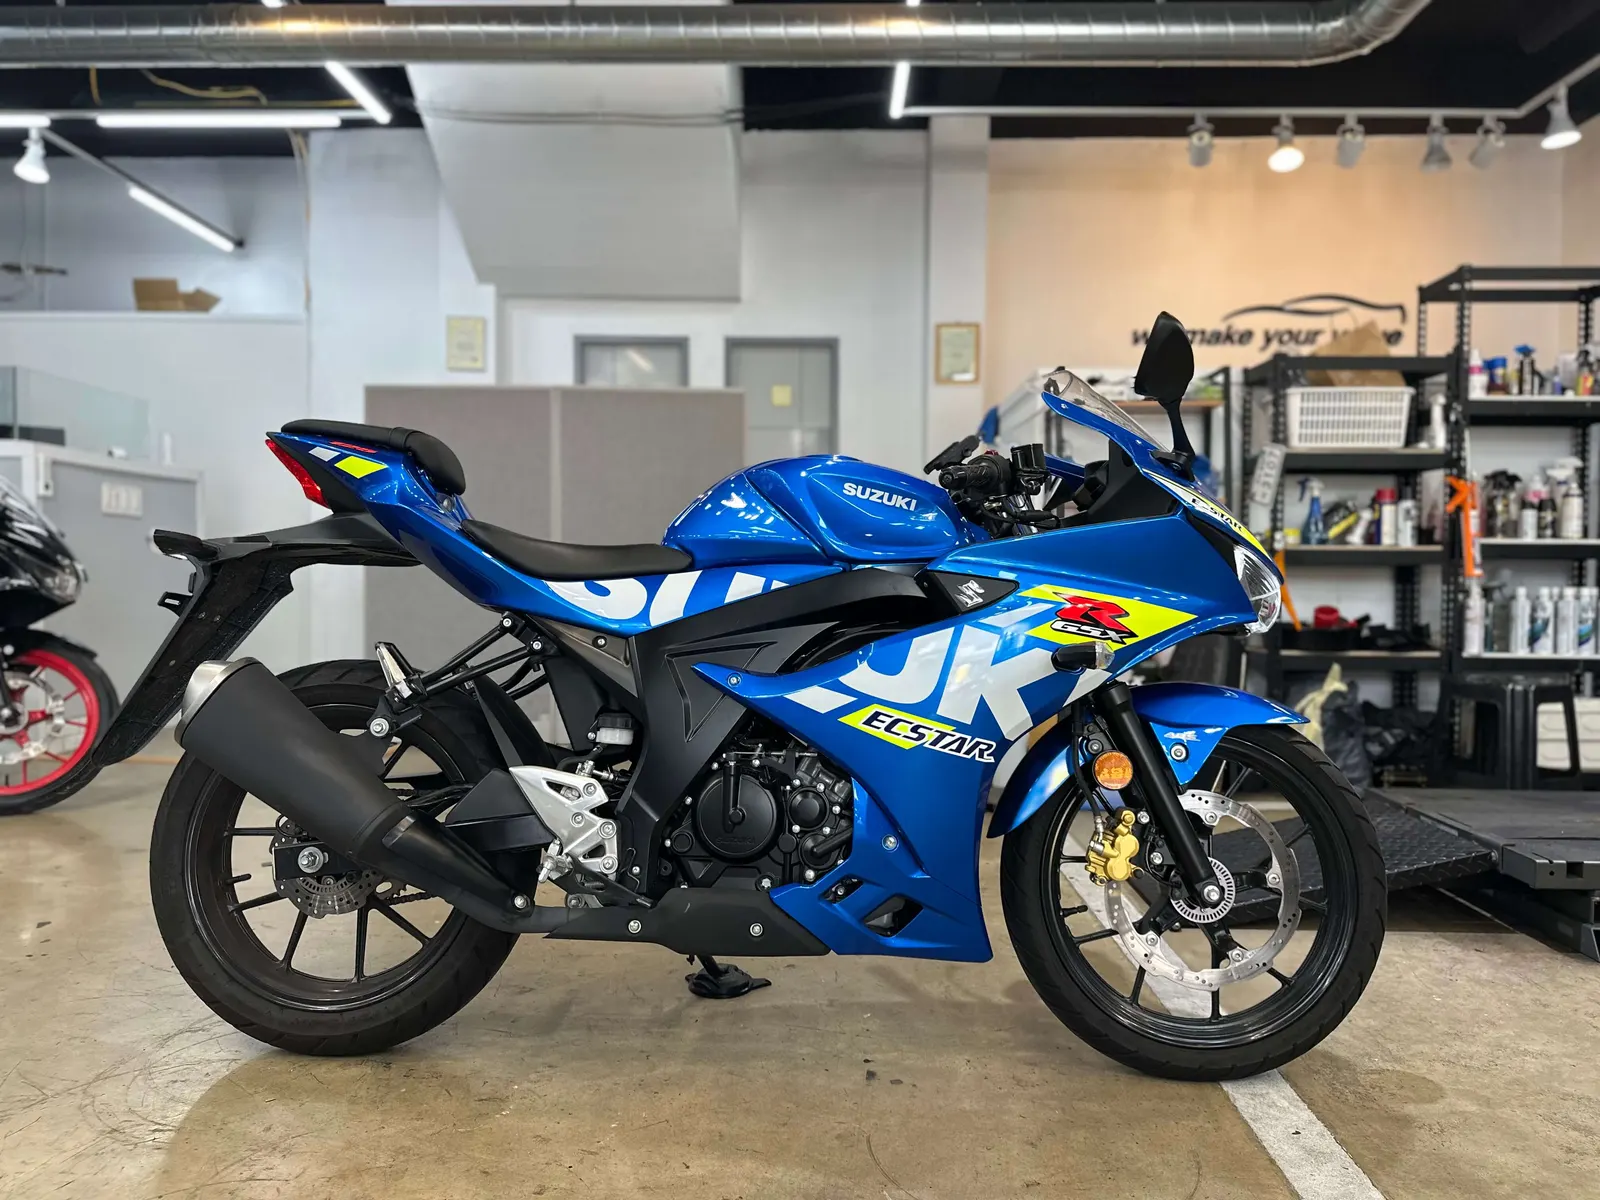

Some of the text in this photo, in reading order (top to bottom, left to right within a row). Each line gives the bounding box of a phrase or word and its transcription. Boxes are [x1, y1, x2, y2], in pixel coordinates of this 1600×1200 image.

[1187, 324, 1253, 346] make
[1259, 328, 1325, 351] your
[843, 482, 917, 511] SUZUKI
[1052, 591, 1137, 636] R
[1050, 620, 1127, 645] GSX
[860, 709, 996, 762] ECSTAR
